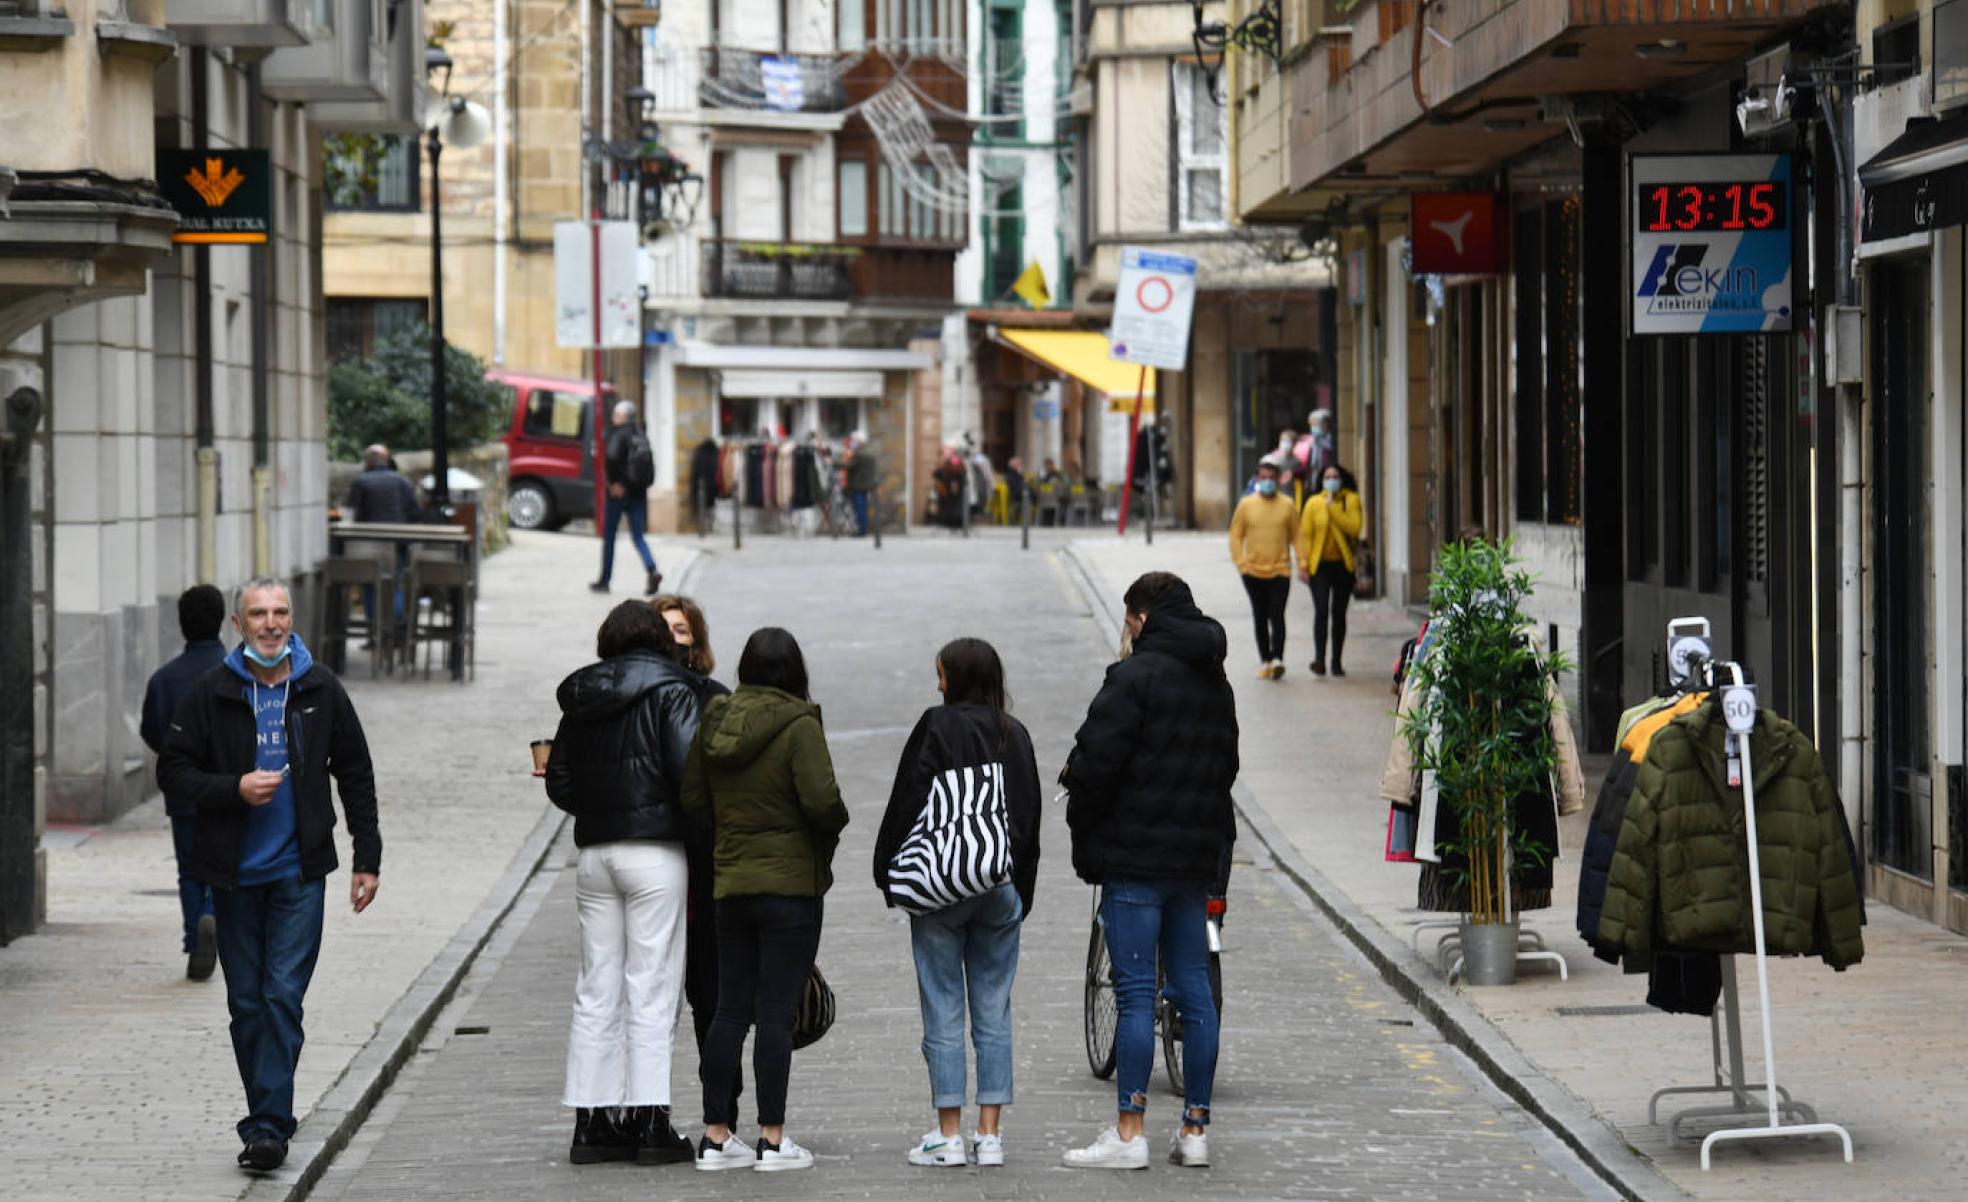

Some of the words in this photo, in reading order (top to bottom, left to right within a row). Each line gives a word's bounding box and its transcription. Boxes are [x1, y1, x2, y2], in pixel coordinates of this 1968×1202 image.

[1649, 184, 1774, 231] 13:15
[212, 217, 265, 230] KUTXA
[1678, 266, 1756, 294] ekin
[1727, 701, 1750, 718] 50
